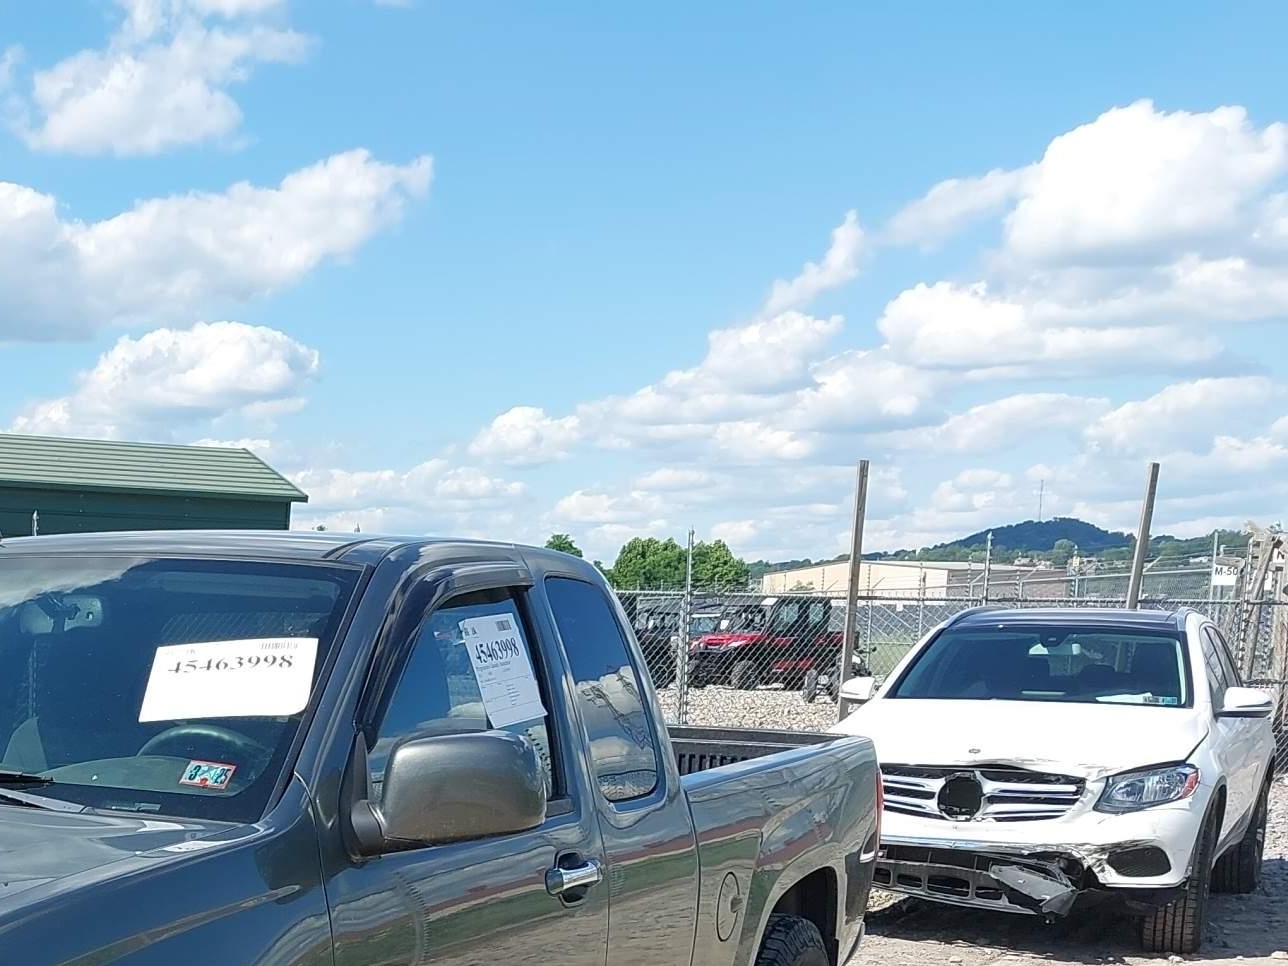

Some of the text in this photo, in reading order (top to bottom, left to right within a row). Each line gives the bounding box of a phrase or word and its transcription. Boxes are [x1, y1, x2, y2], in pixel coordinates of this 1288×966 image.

[475, 637, 520, 664] 45463998
[168, 654, 293, 674] 45463998
[188, 764, 202, 780] 3
